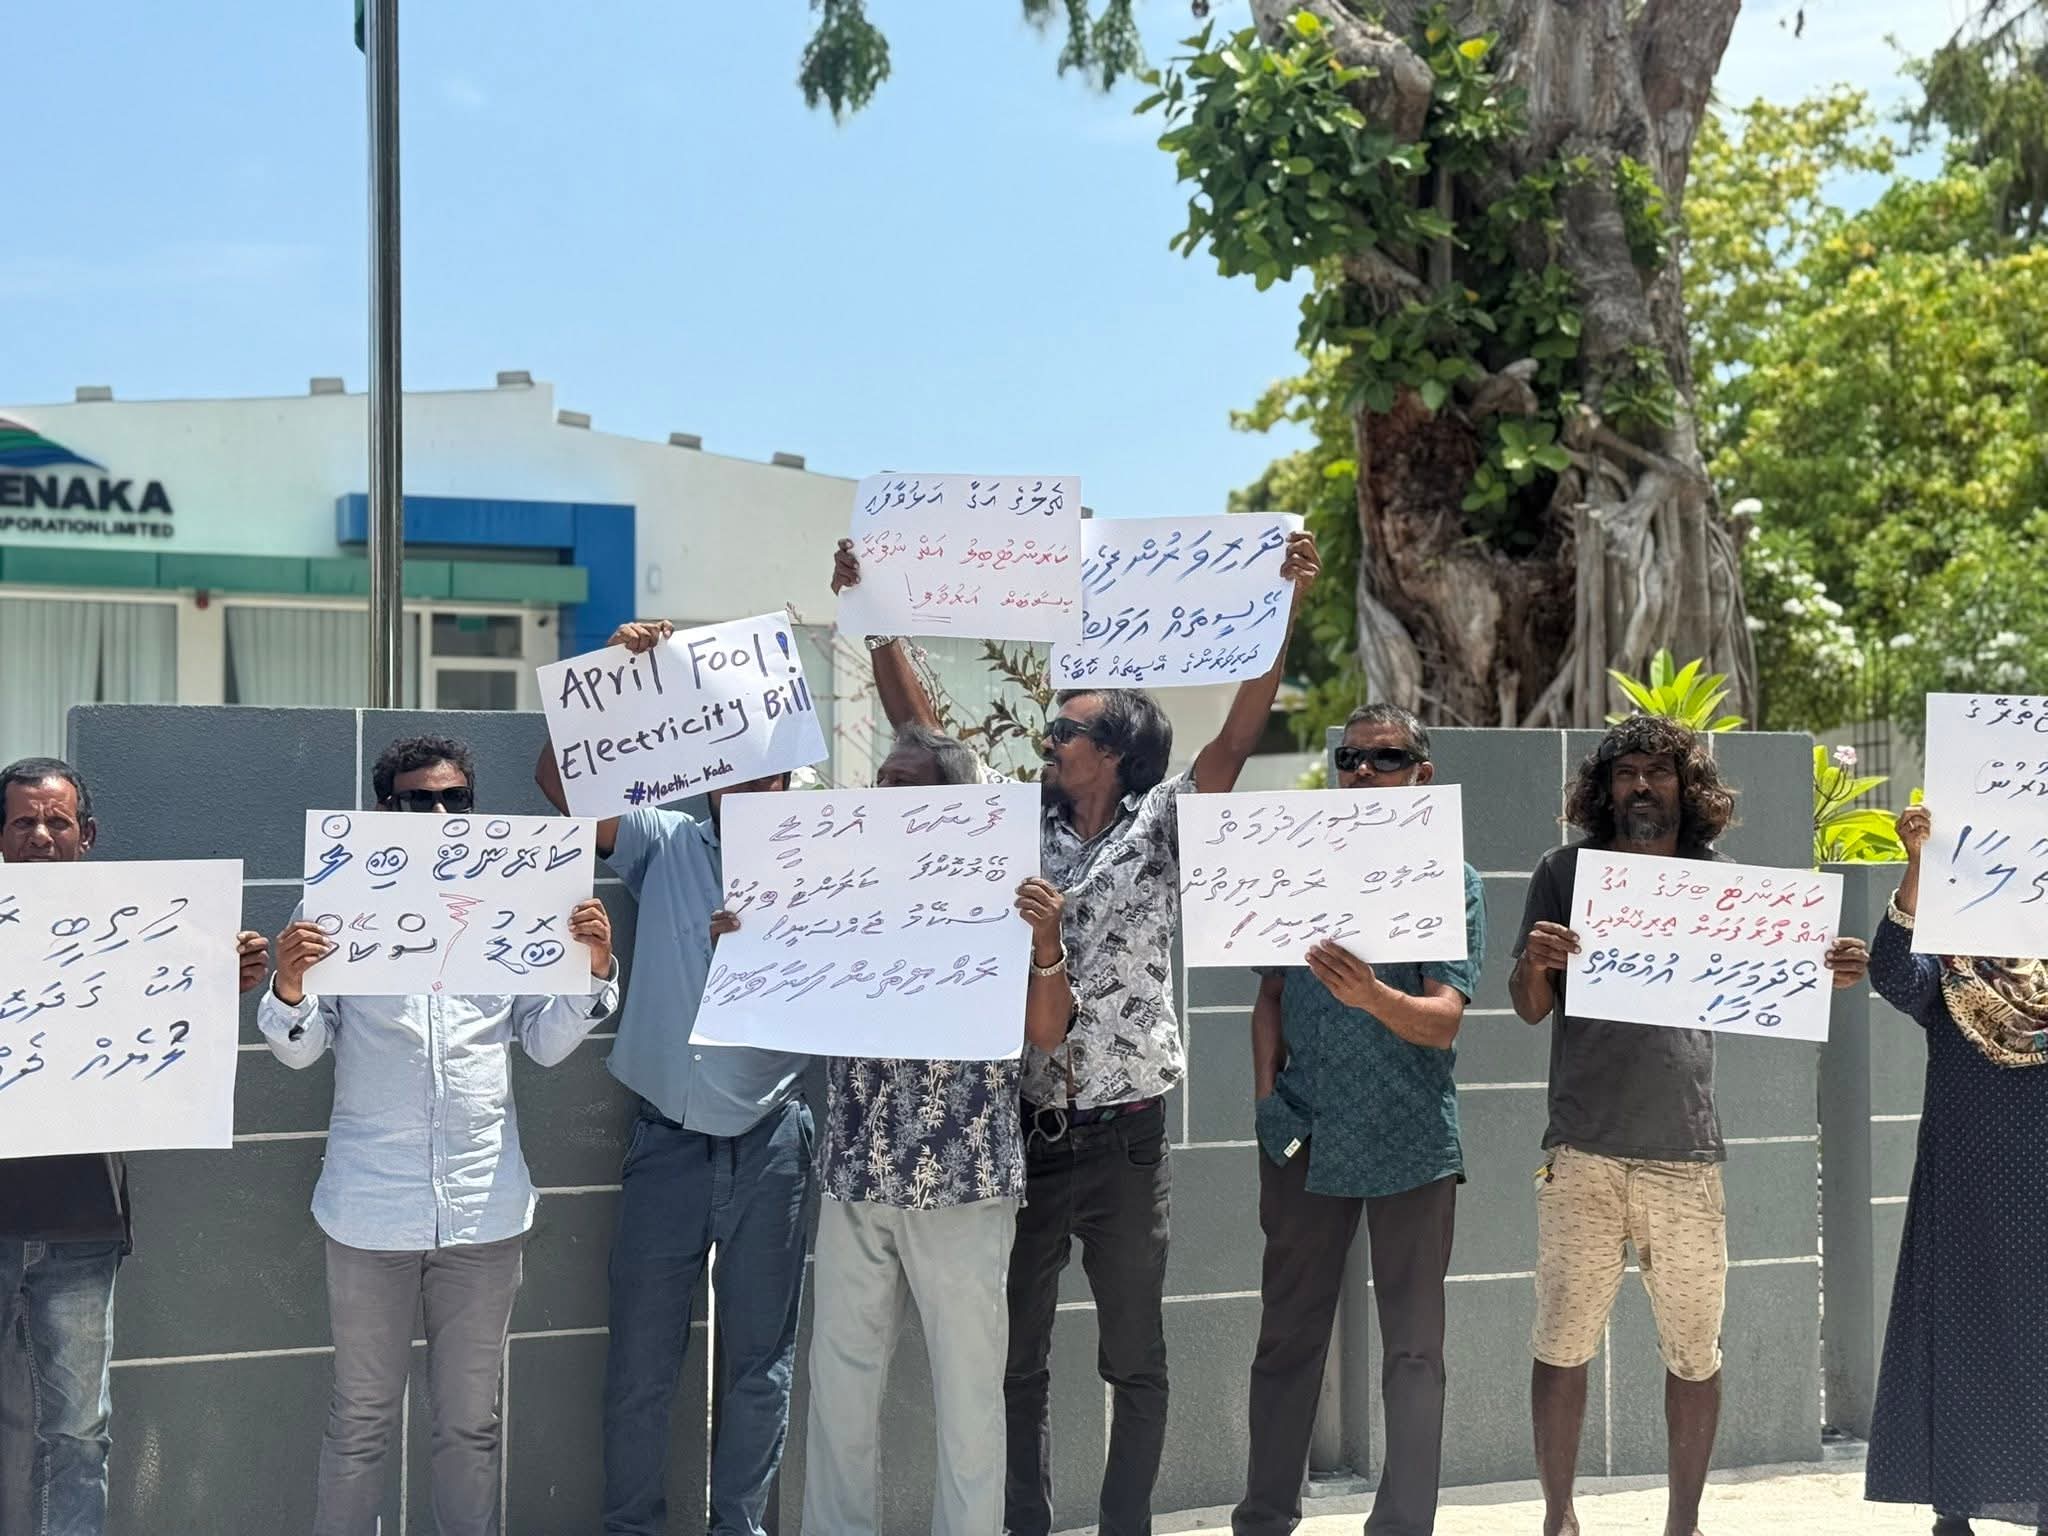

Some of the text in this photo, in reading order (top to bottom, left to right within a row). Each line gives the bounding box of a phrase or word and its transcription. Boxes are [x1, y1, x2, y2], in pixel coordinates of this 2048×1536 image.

[559, 648, 663, 712] April
[560, 676, 812, 780] Electricity Bill
